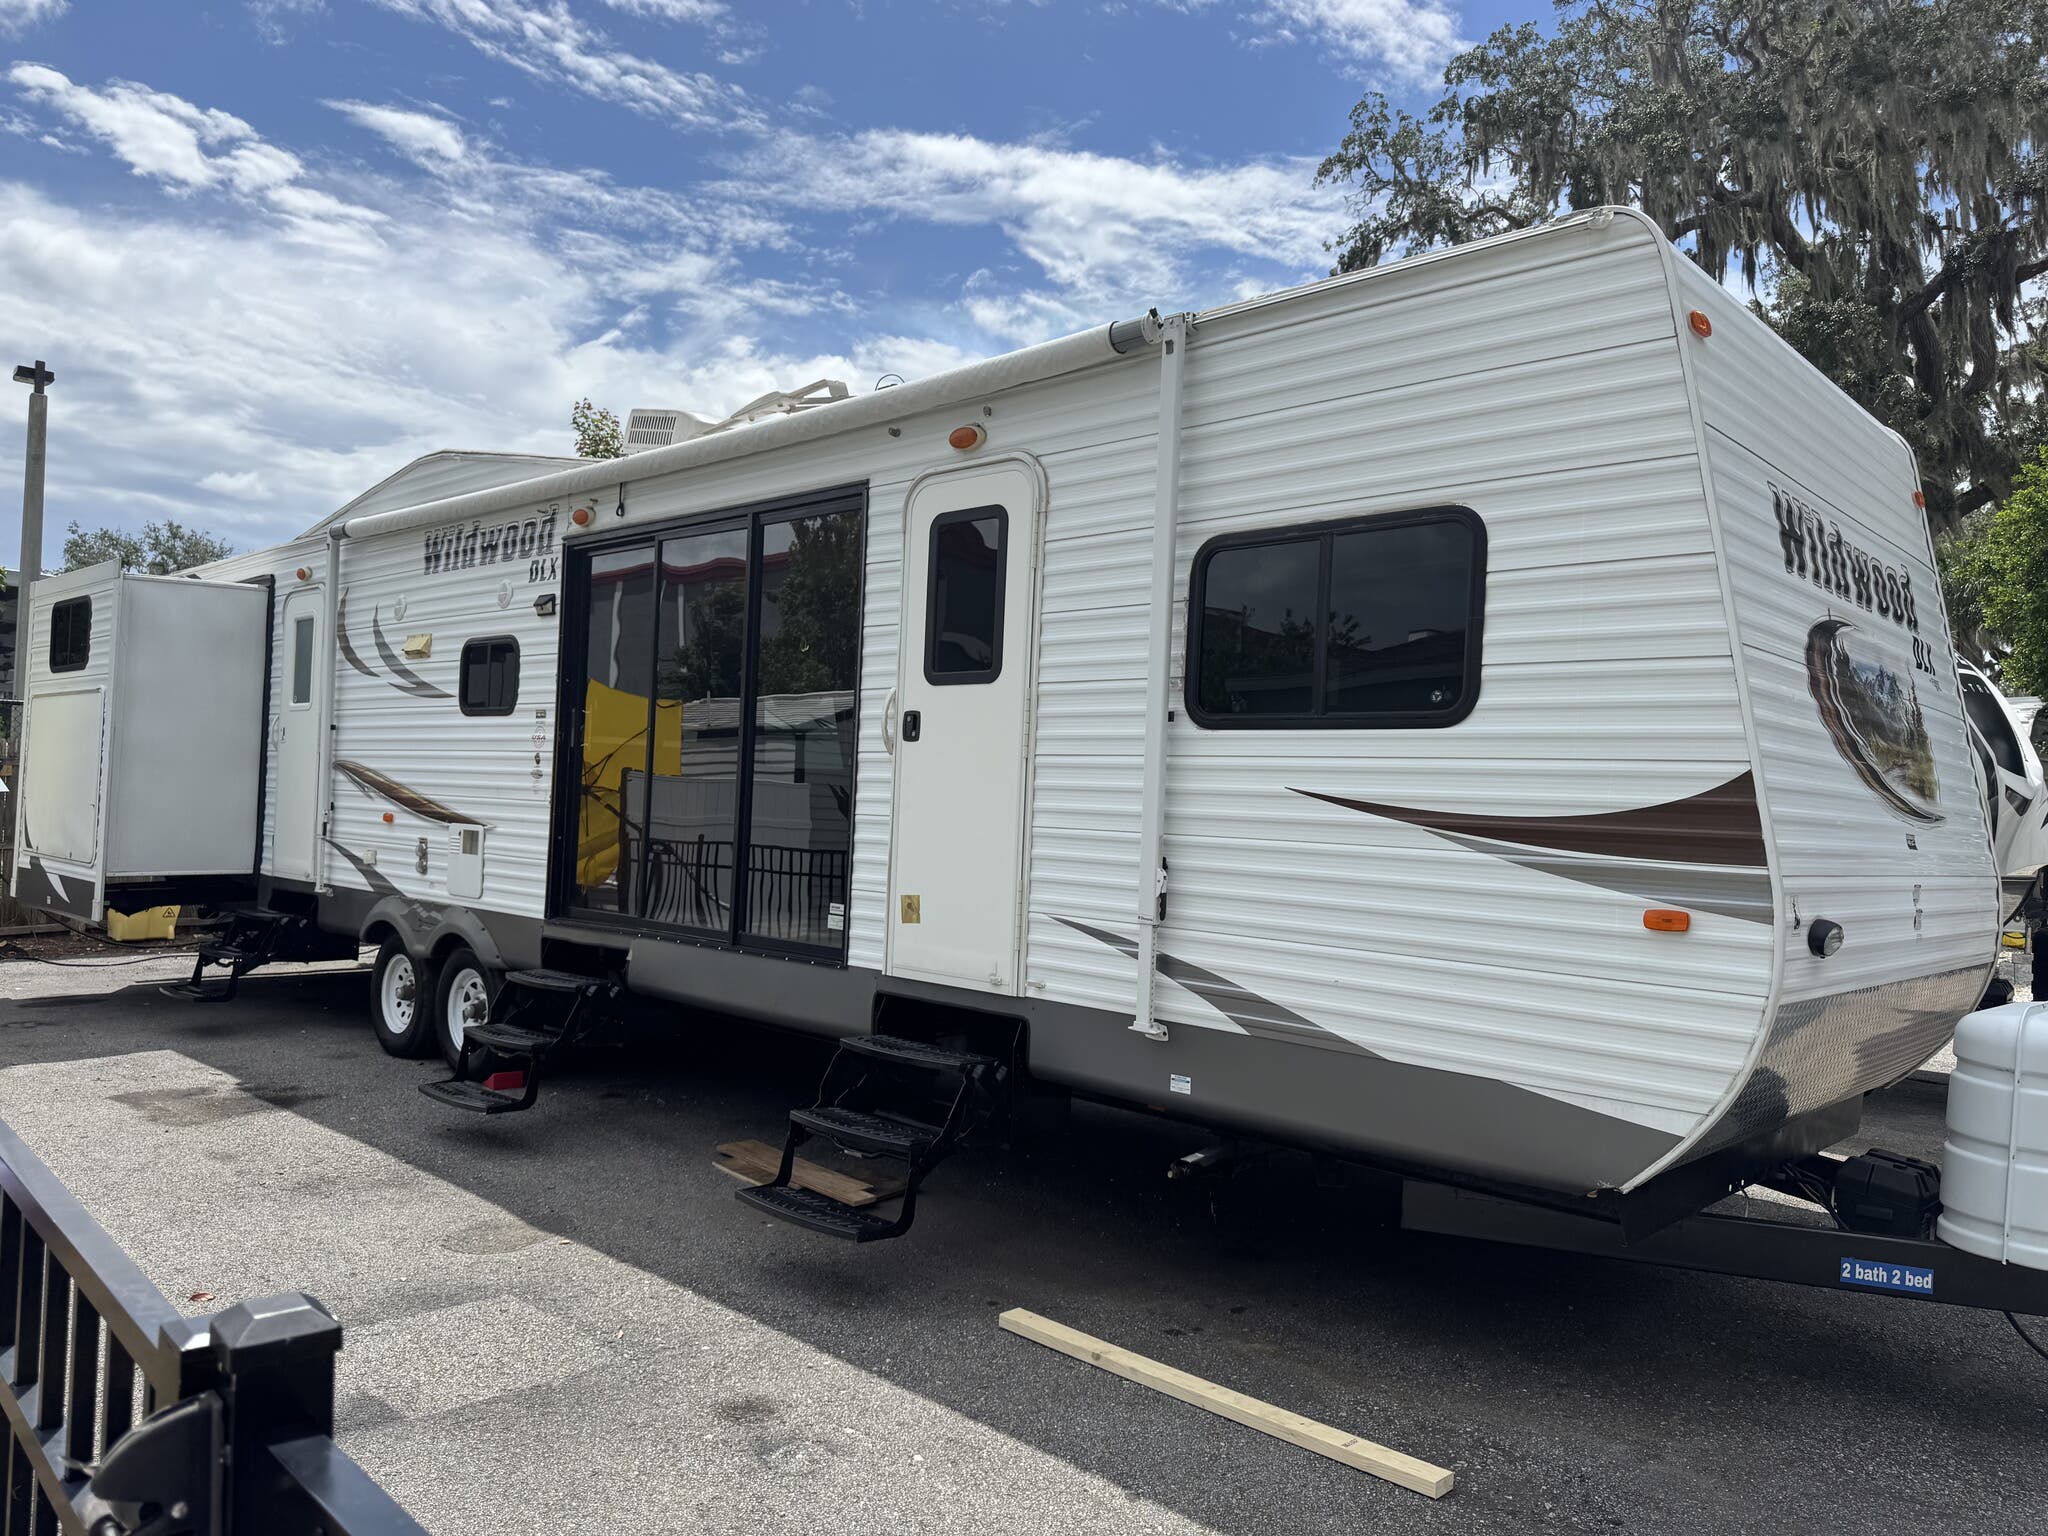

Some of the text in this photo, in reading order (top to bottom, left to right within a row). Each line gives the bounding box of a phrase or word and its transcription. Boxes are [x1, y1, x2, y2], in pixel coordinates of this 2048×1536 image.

[424, 504, 559, 575] Wildwood
[1767, 480, 1919, 635] Wildwood
[529, 557, 558, 583] DLX
[1842, 1263, 1932, 1289] 2 bath 2 bed
